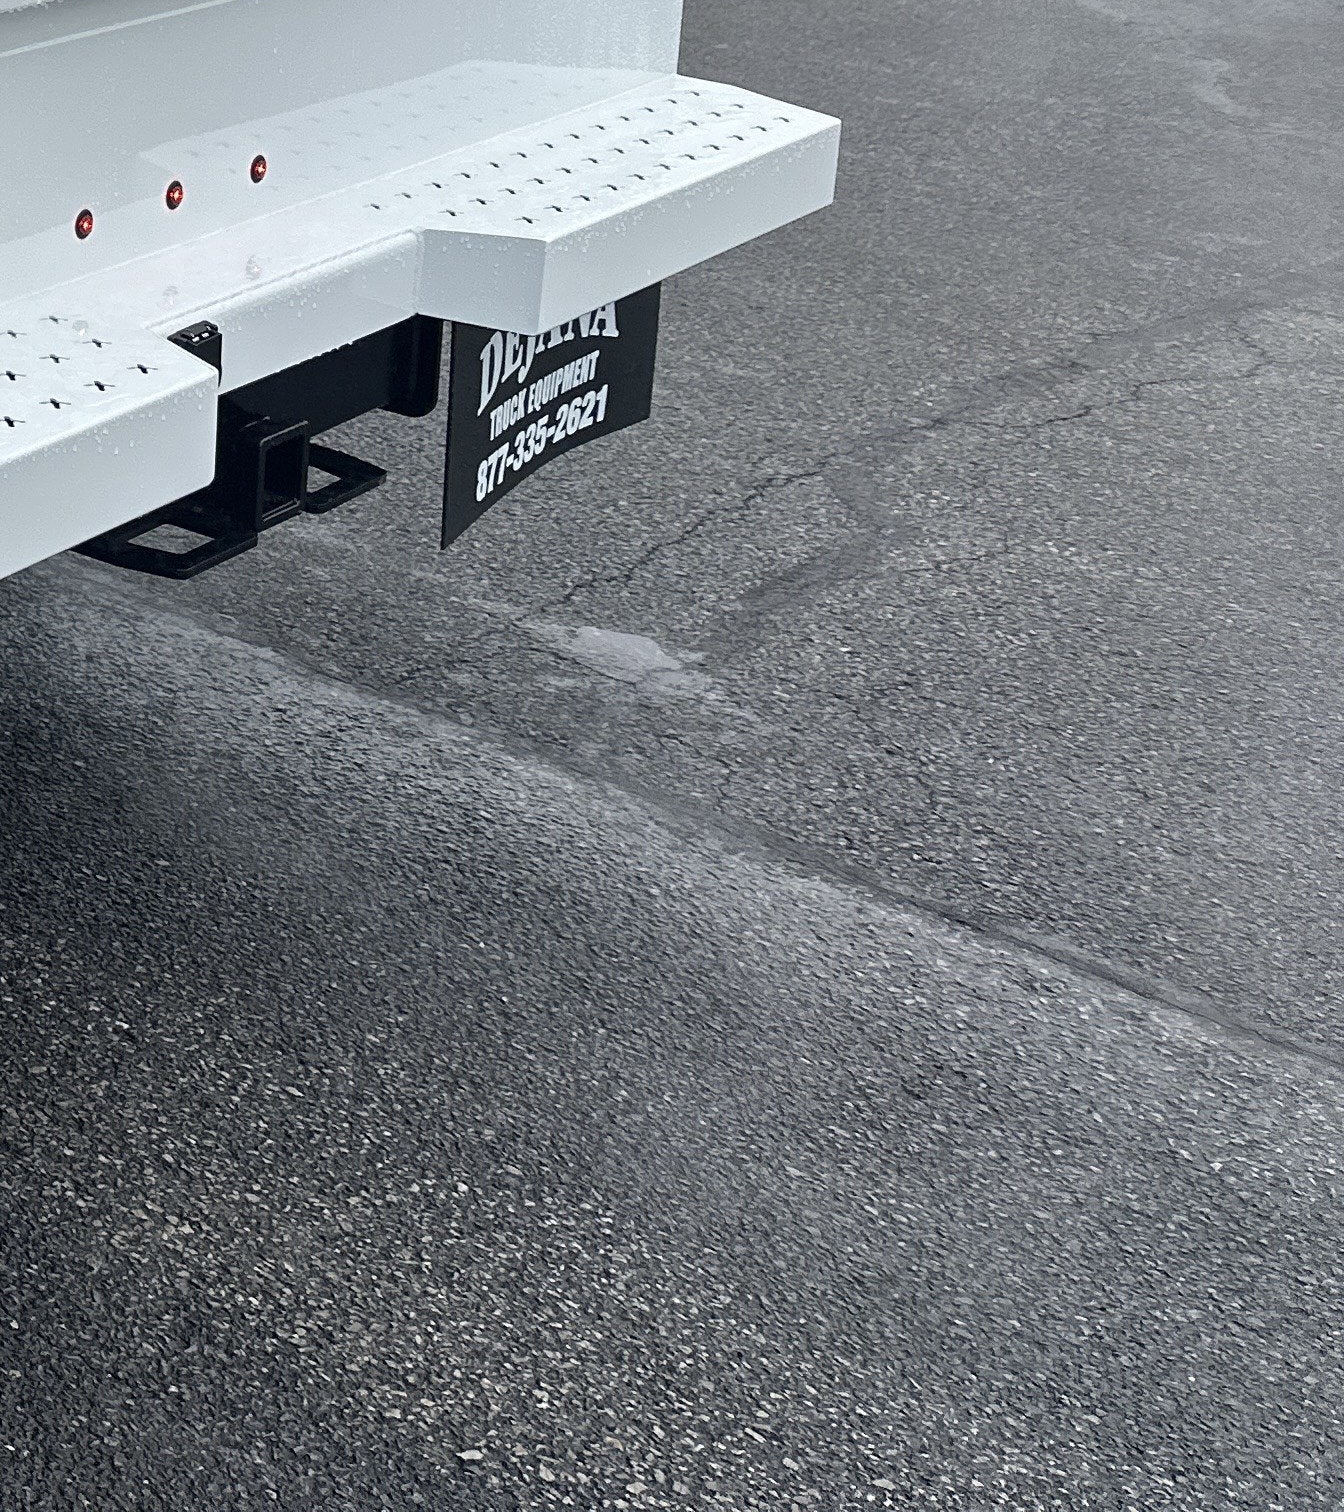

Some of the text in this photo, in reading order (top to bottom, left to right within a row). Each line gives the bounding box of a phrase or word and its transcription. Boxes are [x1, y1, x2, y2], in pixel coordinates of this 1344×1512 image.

[477, 301, 620, 418] DEJA
[489, 349, 600, 441] TRUCK EQUIPMENT
[476, 383, 609, 502] 877-335-2621
